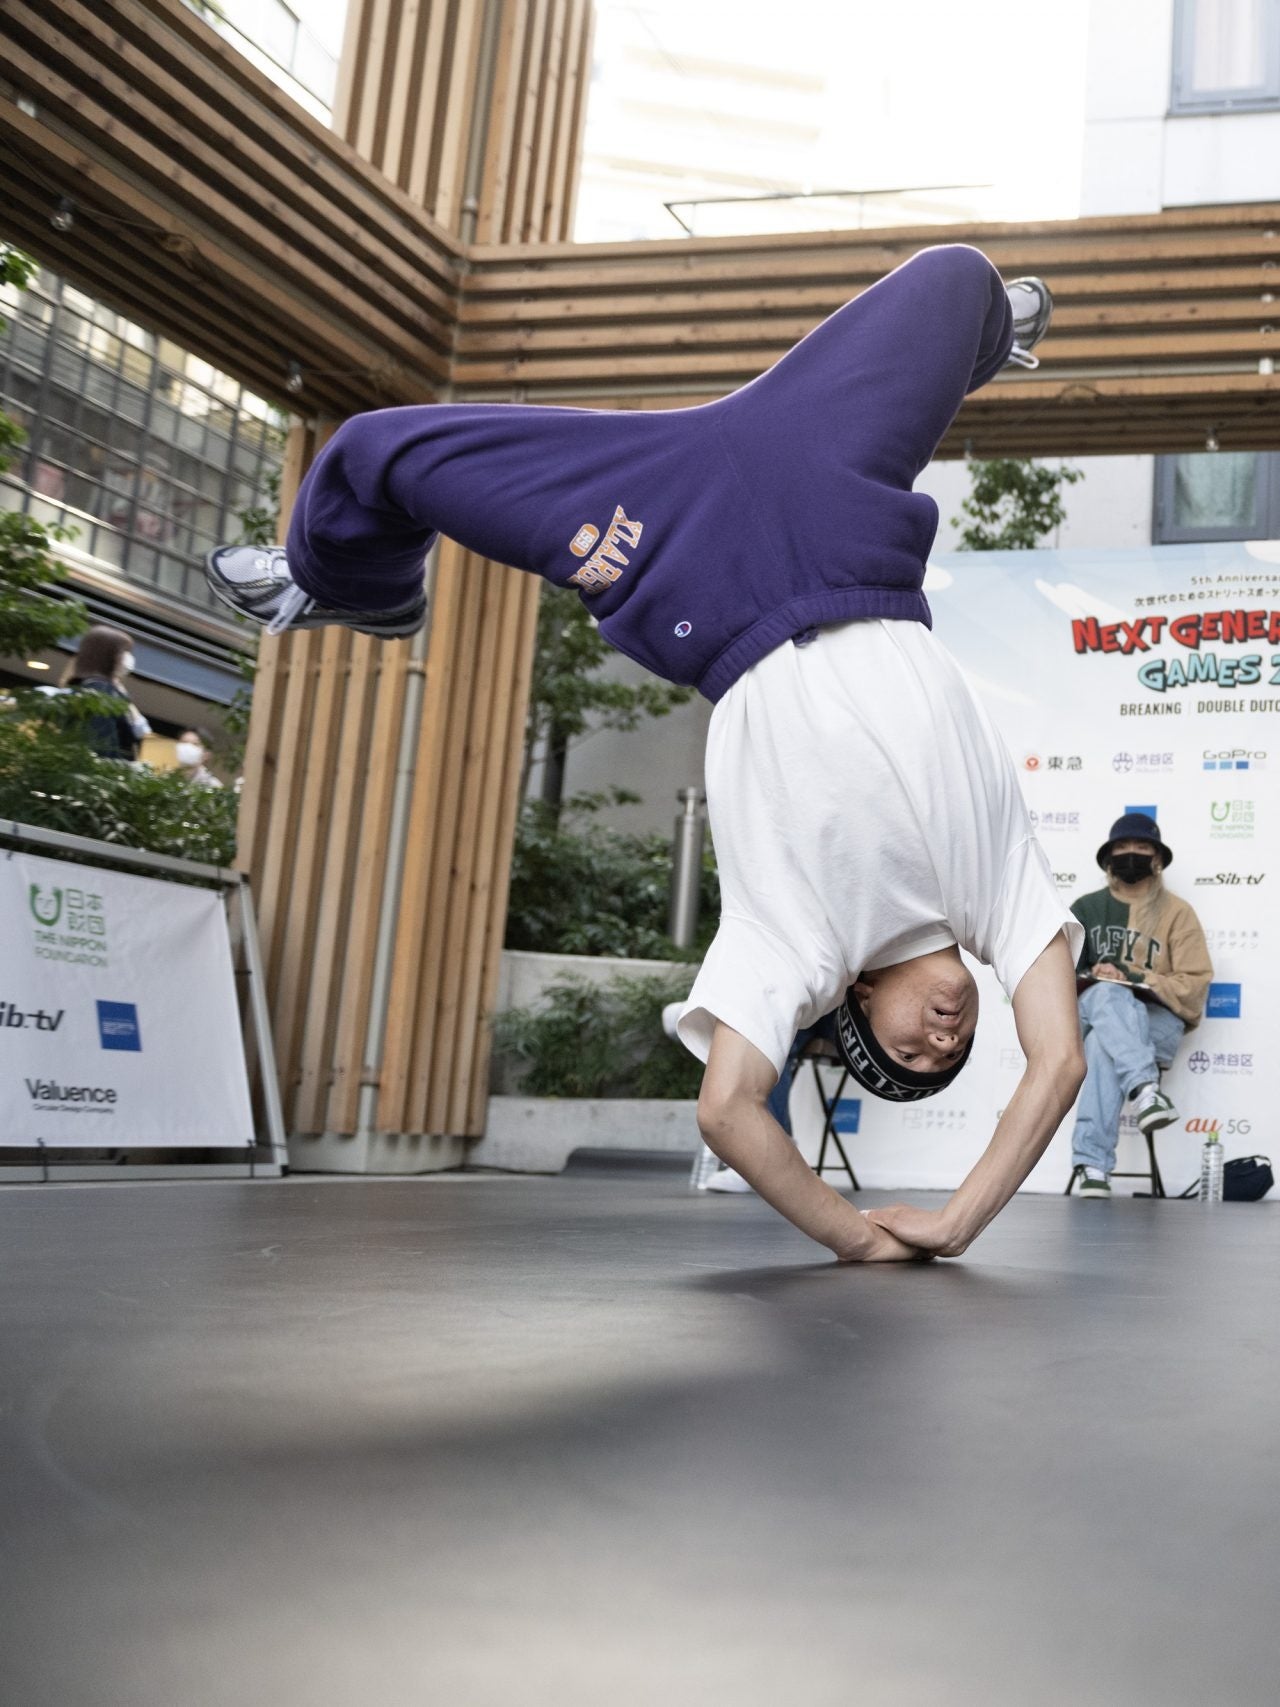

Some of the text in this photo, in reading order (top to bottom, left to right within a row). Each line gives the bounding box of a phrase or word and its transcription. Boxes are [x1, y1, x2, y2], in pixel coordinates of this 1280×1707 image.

[1191, 576, 1212, 585] 5th
[1071, 615, 1167, 655] NEXT
[1137, 652, 1262, 693] GAMES
[1120, 702, 1182, 716] BREAKING
[1197, 700, 1246, 714] DOUBLE
[1203, 749, 1267, 760] GoPro
[1047, 756, 1083, 771] 東急
[66, 888, 104, 911] 日本
[0, 1001, 65, 1032] ib.tv
[1213, 1053, 1253, 1067] 渋谷区
[25, 1078, 118, 1104] Valuence
[1185, 1118, 1252, 1135] au 5G
